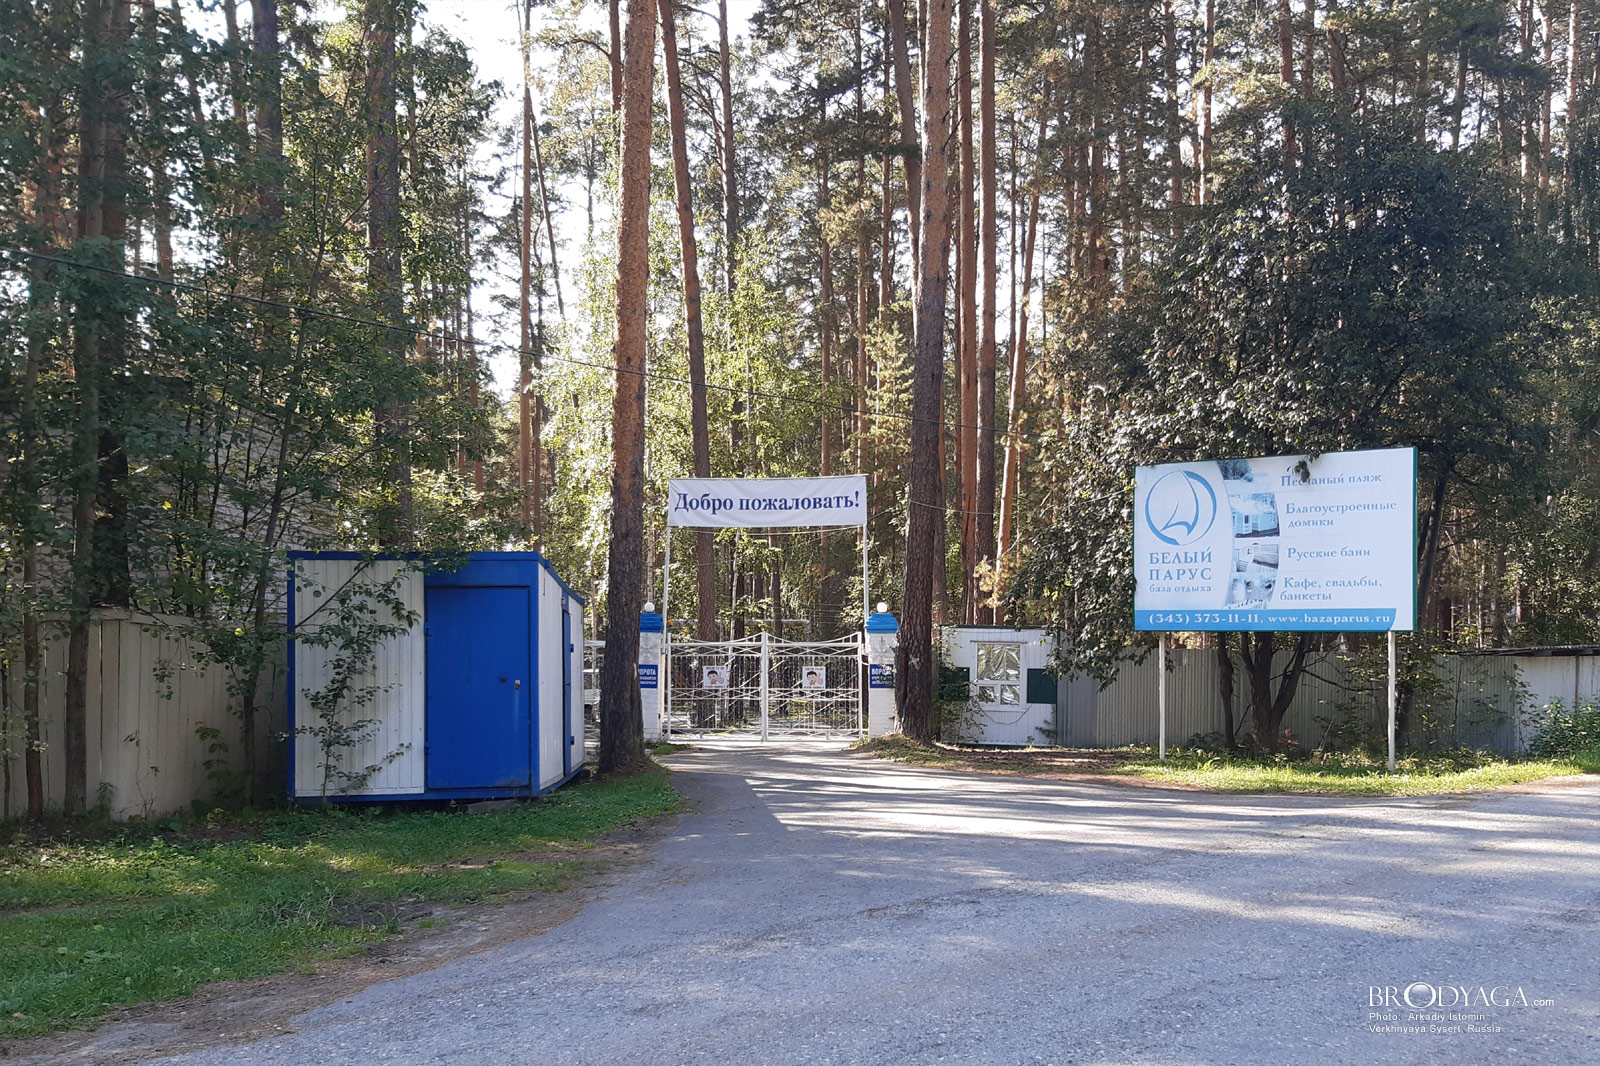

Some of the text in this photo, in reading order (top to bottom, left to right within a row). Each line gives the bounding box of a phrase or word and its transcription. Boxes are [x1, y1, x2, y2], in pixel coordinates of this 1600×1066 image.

[1281, 473, 1382, 487] Песаный пляж
[675, 490, 860, 515] Добро пожаловать!
[1286, 502, 1397, 516] Благоустроенные
[1288, 519, 1334, 528] домики
[1149, 546, 1212, 565] БЕЛЫЙ
[1287, 547, 1370, 560] Русские бани
[1149, 568, 1212, 580] ПАРУС
[1149, 584, 1171, 592] база
[1284, 577, 1383, 589] Кафе, свадьбы,
[1280, 591, 1332, 601] банкеты
[1149, 613, 1390, 625] (343) 373-11-11, www.bazaparus.ru
